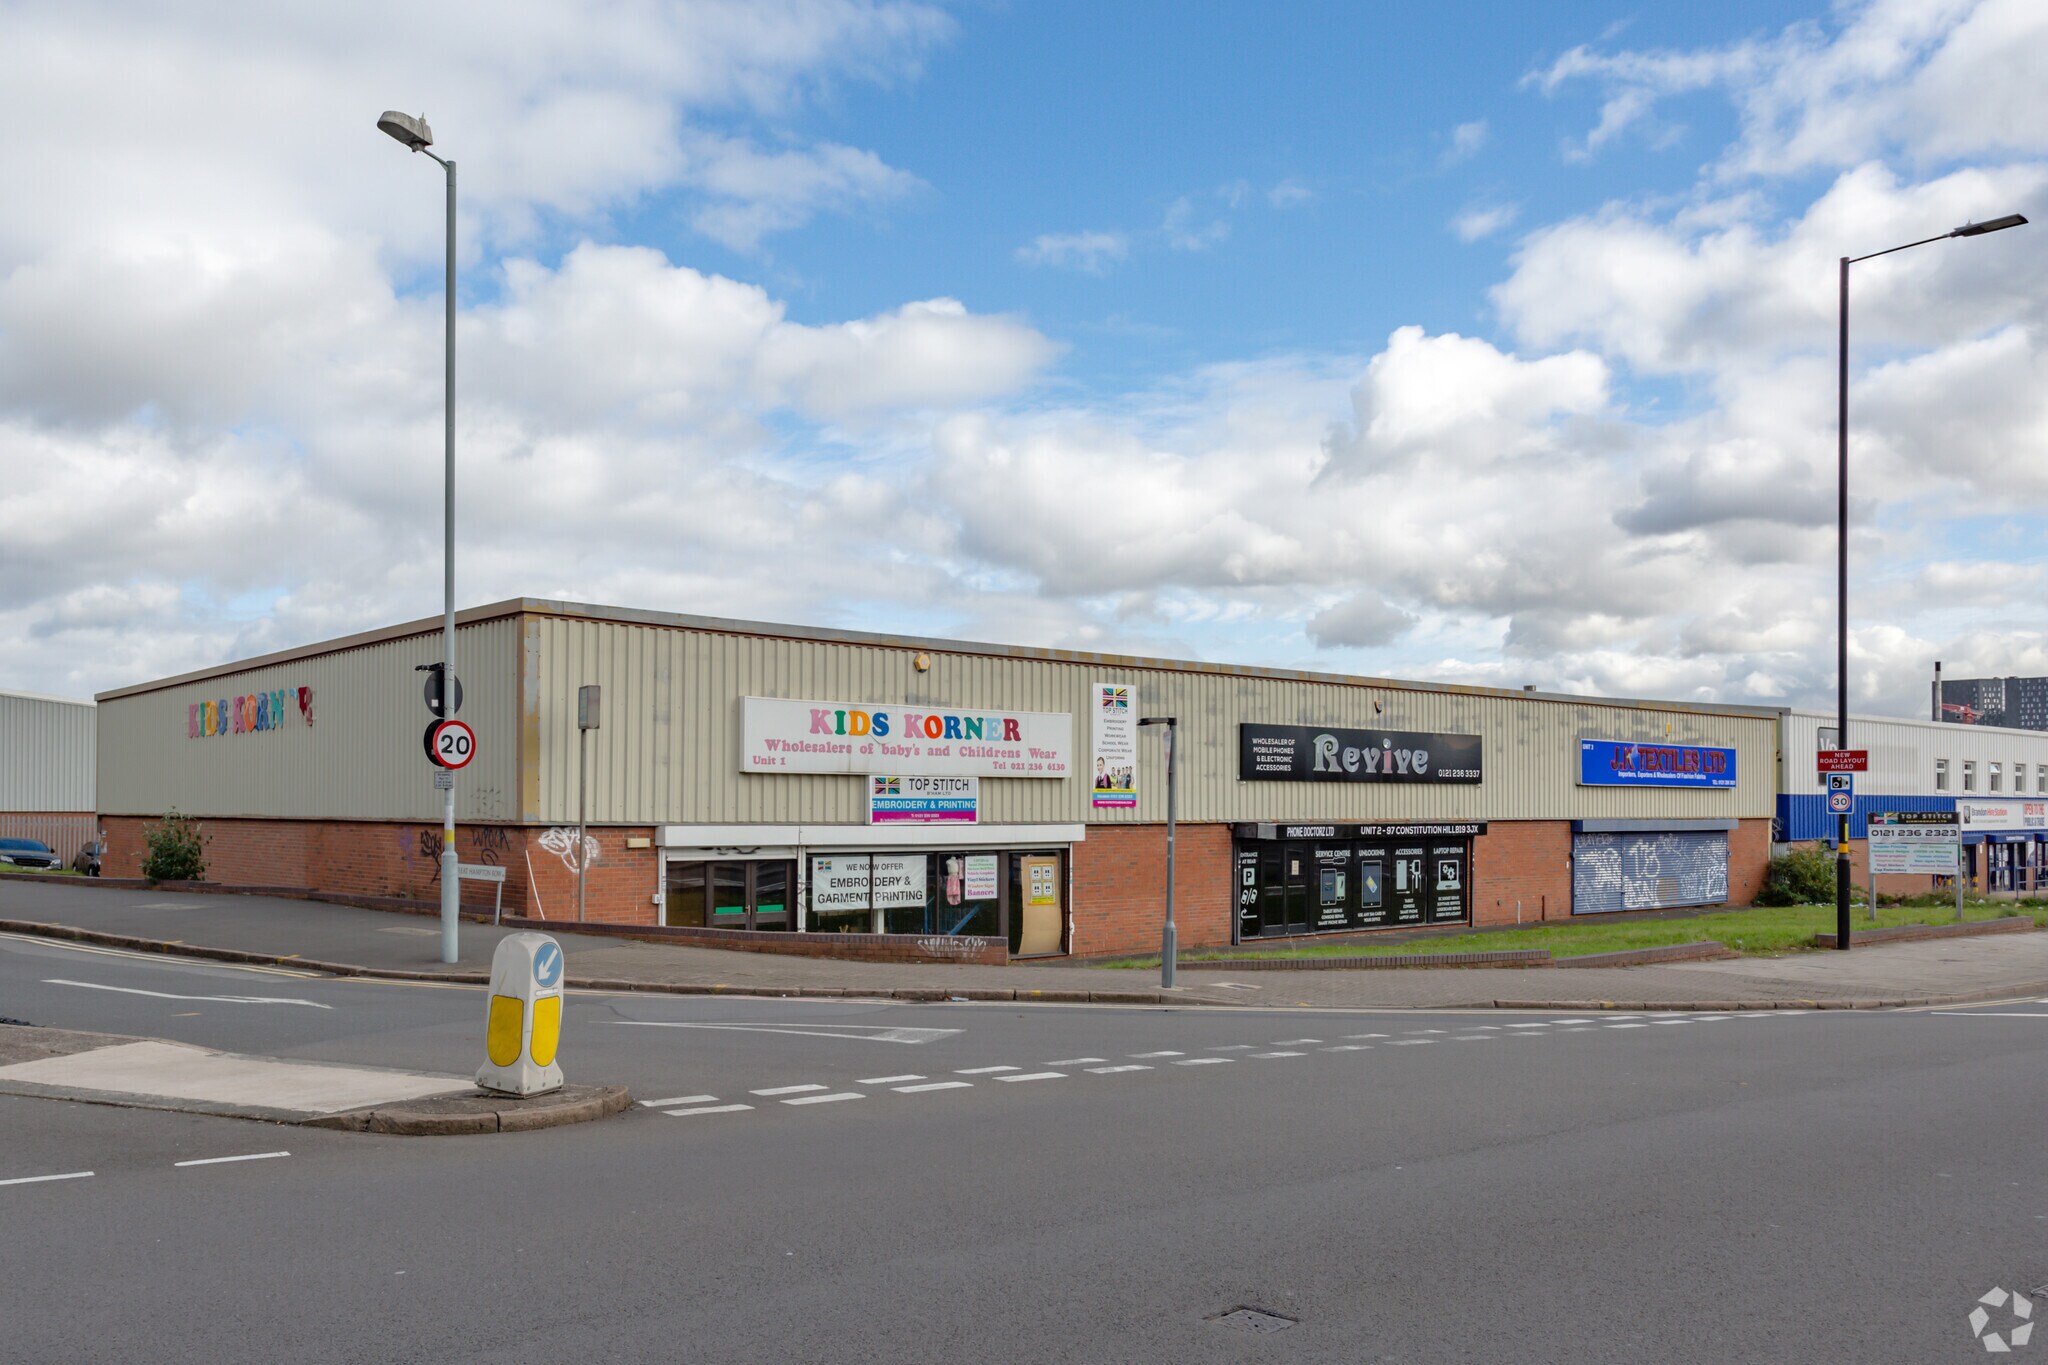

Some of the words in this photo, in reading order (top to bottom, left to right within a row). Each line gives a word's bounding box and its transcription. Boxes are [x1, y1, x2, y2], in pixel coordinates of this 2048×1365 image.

[188, 699, 228, 738] KIDS
[232, 686, 313, 734] KORNR
[1112, 707, 1128, 715] STITCH
[809, 708, 890, 737] KIDS
[903, 713, 1022, 742] KORNER
[440, 734, 470, 756] 20
[1251, 738, 1288, 746] WHOLESALER
[764, 738, 852, 754] Wholesalers
[859, 742, 874, 755] of
[881, 743, 920, 758] baby's
[927, 745, 950, 757] and
[959, 746, 1021, 759] Childrens
[1028, 747, 1057, 760] Wear
[1253, 746, 1273, 754] MOBILE
[1273, 747, 1295, 755] PHONES
[1312, 733, 1429, 775] Revive
[752, 755, 776, 765] Unit
[779, 756, 786, 765] 1
[1261, 755, 1293, 763] ELECTRONIC
[1611, 745, 1637, 771] J.K
[1637, 747, 1700, 773] TEXTILES
[1702, 750, 1727, 774] LTD
[992, 761, 1007, 770] Tel
[1010, 762, 1025, 770] 021
[1028, 763, 1043, 771] 236
[1047, 763, 1066, 771] 6130
[1255, 764, 1292, 772] ACCESSORIES
[1438, 769, 1453, 778] 0121
[1453, 769, 1465, 779] 236
[1465, 769, 1481, 779] 3337
[908, 778, 930, 791] TOP
[933, 778, 970, 791] STITCH
[872, 800, 928, 809] EMBROIDERY
[929, 800, 936, 809] &
[938, 800, 977, 809] PRINTING
[1833, 797, 1848, 806] 30
[1286, 826, 1303, 838] PHONE
[1303, 826, 1326, 837] DOCTORZ
[1325, 826, 1335, 837] LTD
[1360, 826, 1376, 835] UNIT
[1376, 826, 1382, 835] 2
[1386, 826, 1395, 835] 97
[1395, 825, 1442, 835] CONSTITUTION
[1442, 825, 1456, 834] HILL
[1456, 825, 1466, 834] B19
[1466, 825, 1479, 834] 3JX
[1871, 829, 1895, 837] 0121
[1897, 829, 1922, 837] 236
[1925, 829, 1957, 837] 2323
[1315, 850, 1334, 858] SERVICE
[1333, 849, 1351, 857] CENTRE
[1358, 849, 1385, 857] UNLOCKING
[1395, 848, 1423, 856] ACCESSORIES
[1433, 847, 1450, 855] LAPTOP
[1449, 846, 1464, 854] REPAIR
[846, 863, 858, 871] WE
[859, 863, 880, 871] NOW
[880, 862, 904, 870] OFFER
[830, 876, 902, 888] EMBRODERY
[903, 875, 912, 886] &
[1245, 871, 1253, 883] P
[817, 892, 870, 904] GARMENT
[875, 890, 923, 902] PRINTING
